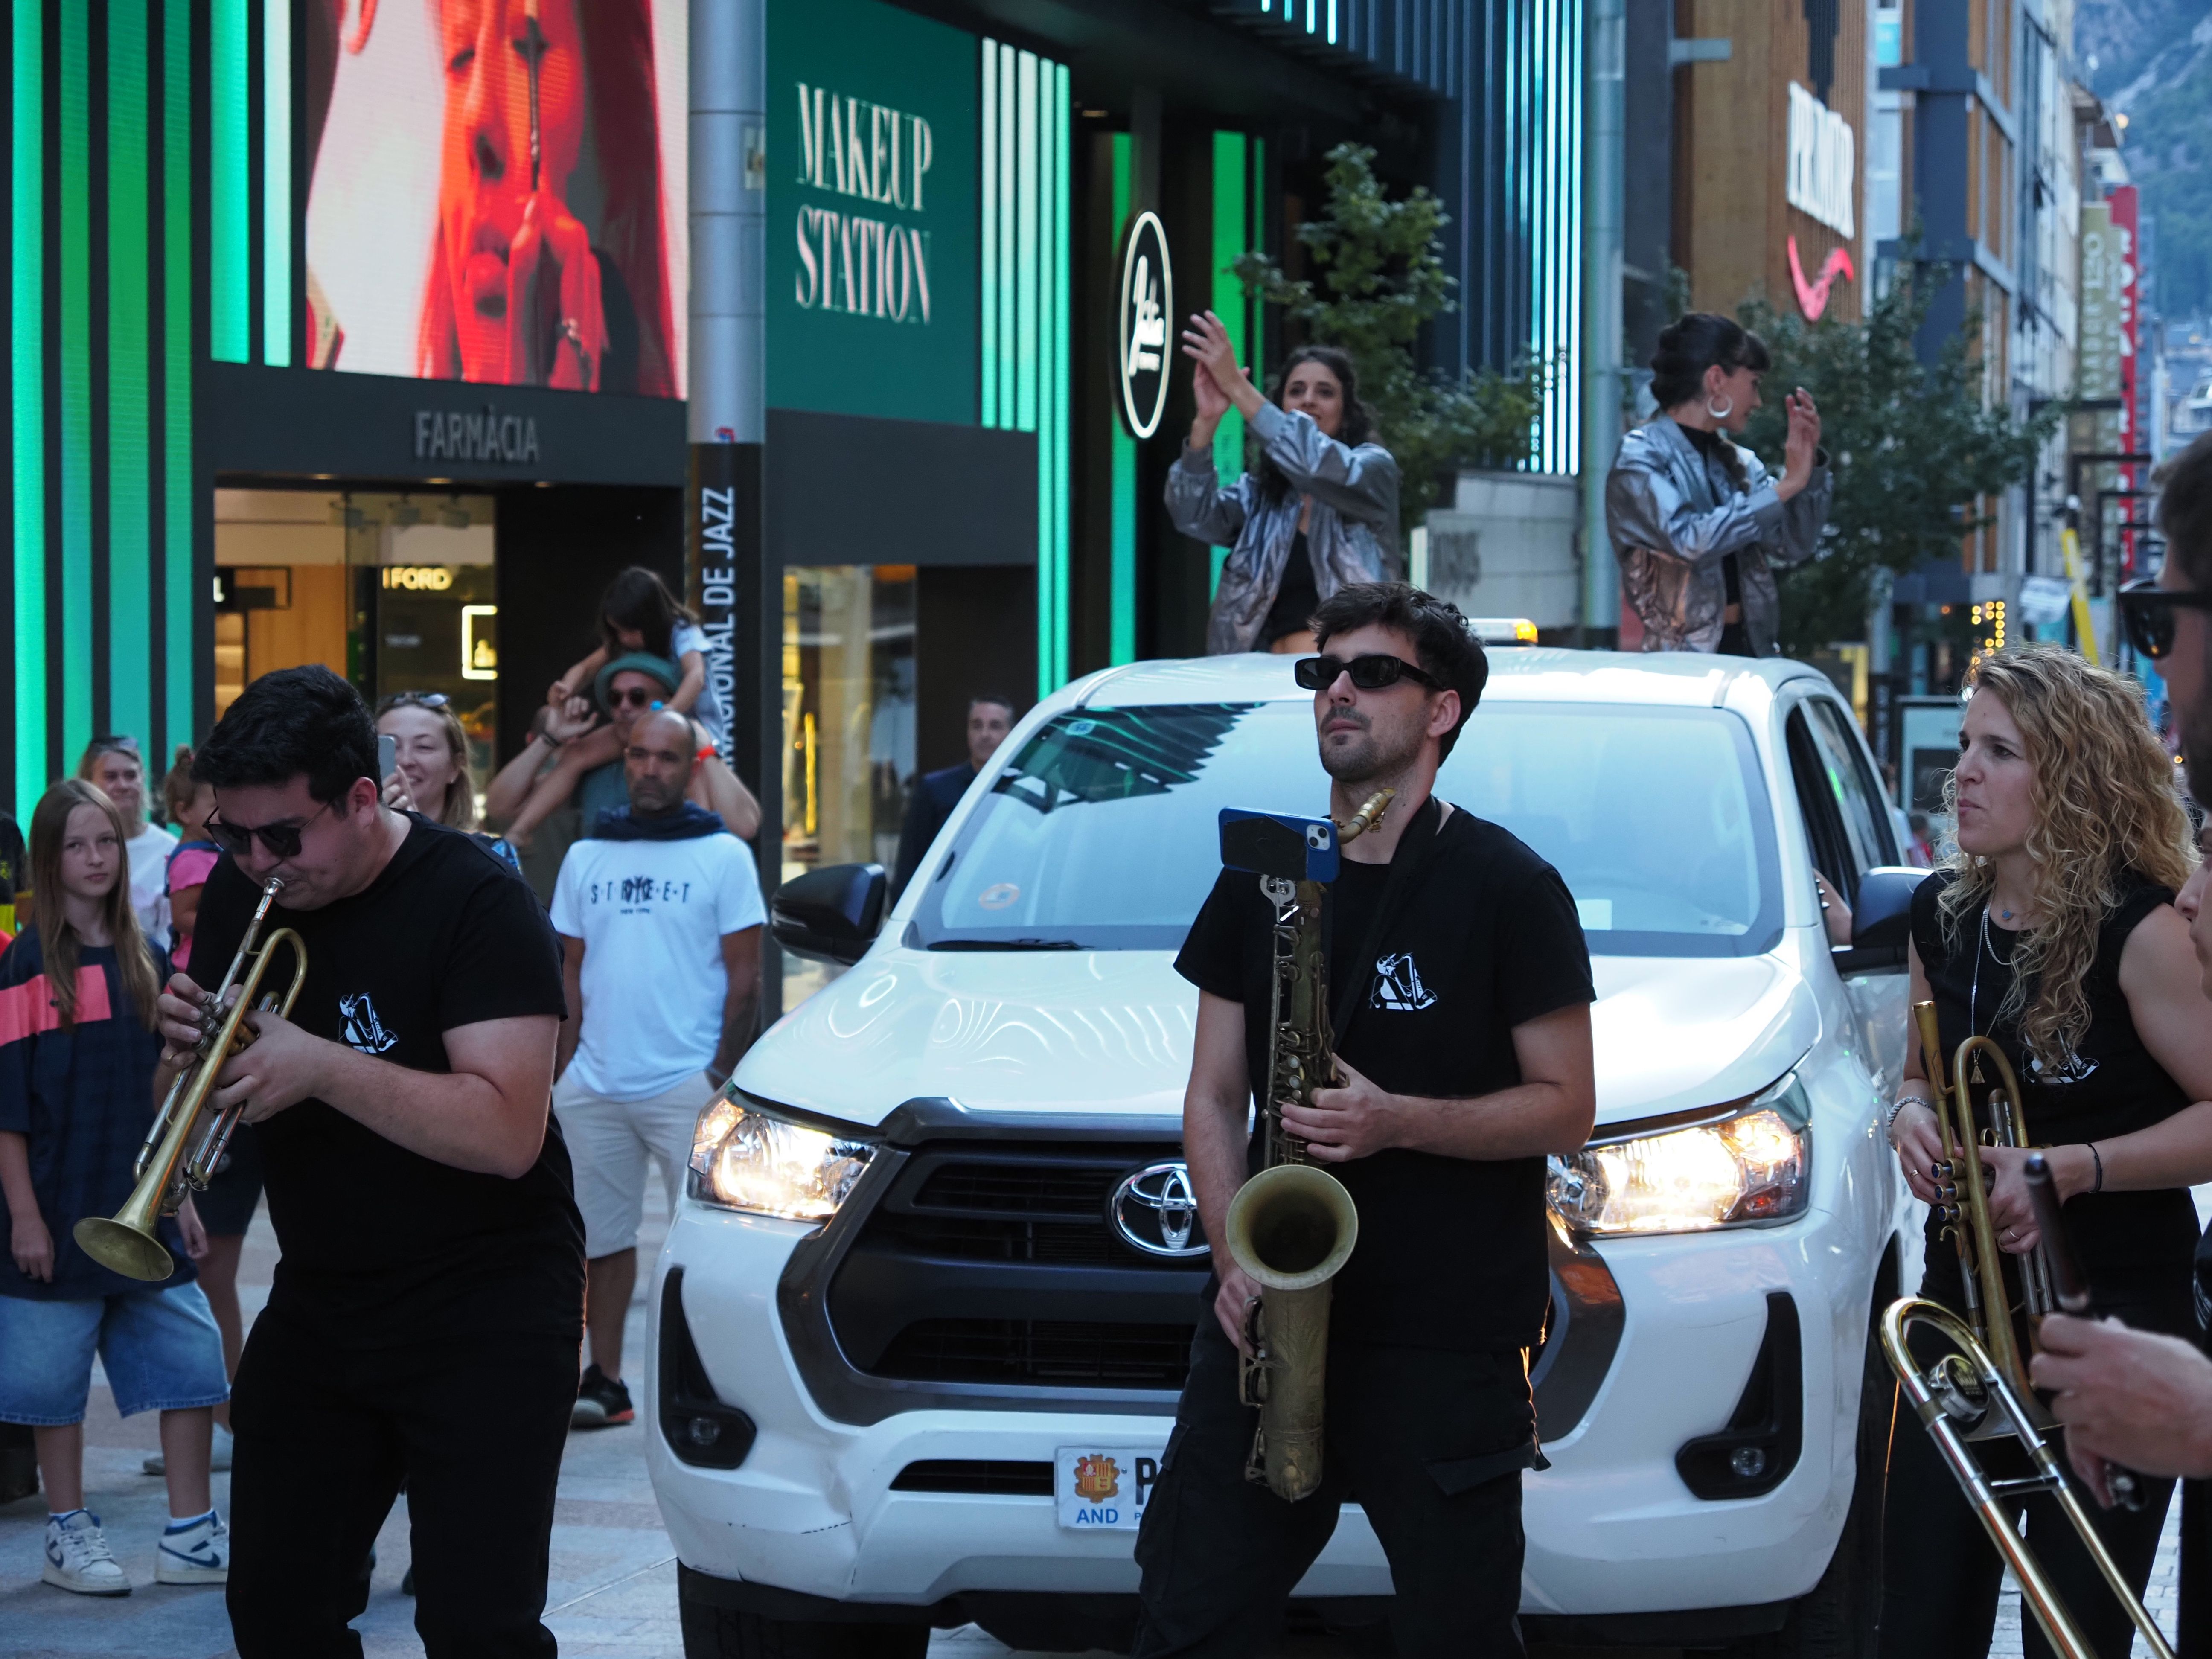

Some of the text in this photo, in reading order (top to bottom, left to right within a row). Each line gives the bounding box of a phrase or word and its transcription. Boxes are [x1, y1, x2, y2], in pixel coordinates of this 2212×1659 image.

[795, 81, 932, 212] MAKEUP
[795, 204, 931, 326] STATION
[415, 404, 539, 463] FARMÀCIA
[702, 486, 735, 561] JAZZ
[702, 566, 735, 605] DE
[1076, 1508, 1118, 1524] AND
